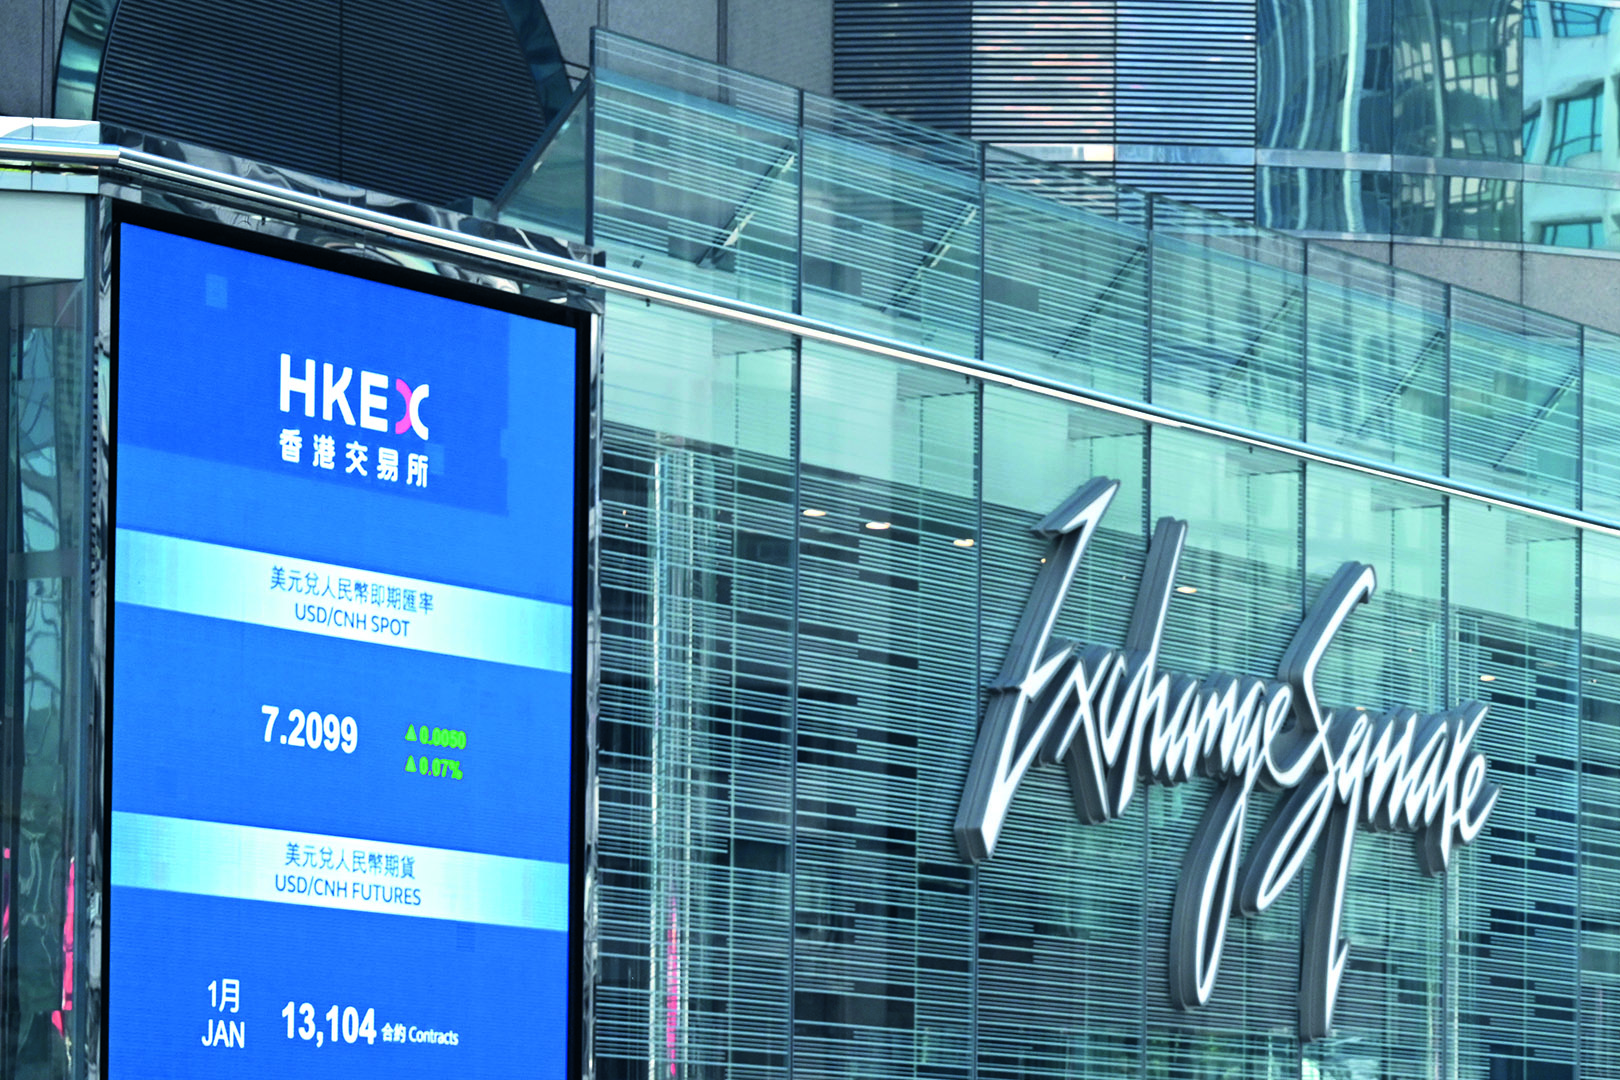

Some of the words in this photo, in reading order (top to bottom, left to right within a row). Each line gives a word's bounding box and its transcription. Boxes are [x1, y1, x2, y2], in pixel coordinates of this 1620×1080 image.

[280, 353, 429, 440] HKEX
[279, 429, 429, 488] 香港交易所
[294, 602, 367, 631] USD/CNH
[370, 615, 411, 637] SPOT
[261, 705, 358, 754] 7.2099
[419, 756, 464, 780] 0.07%
[954, 475, 1292, 1012] Exchange
[1240, 560, 1500, 1042] Square
[274, 873, 348, 902] USD/CNH
[353, 880, 422, 907] FUTURES
[208, 978, 240, 1013] 1月
[201, 1018, 246, 1048] JAN
[282, 1001, 377, 1048] 13,104
[408, 1026, 460, 1046] Contracts
